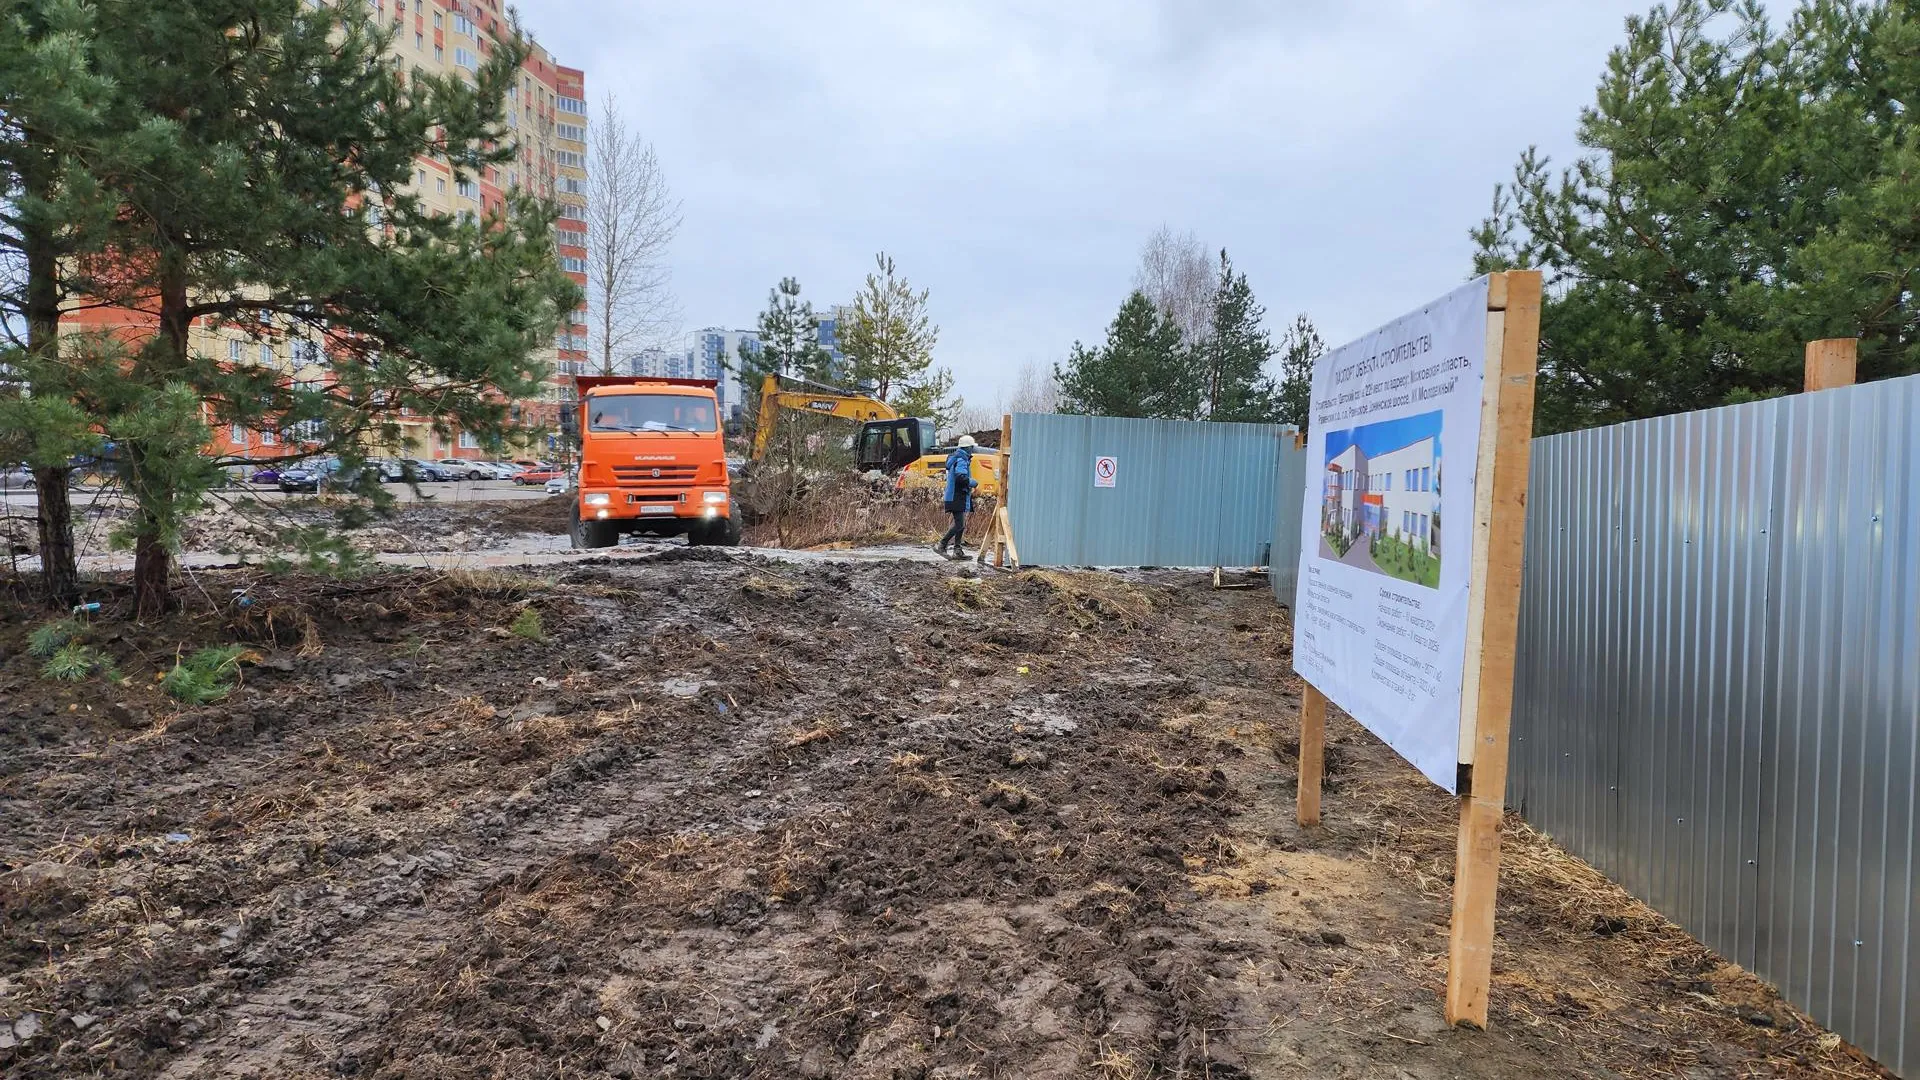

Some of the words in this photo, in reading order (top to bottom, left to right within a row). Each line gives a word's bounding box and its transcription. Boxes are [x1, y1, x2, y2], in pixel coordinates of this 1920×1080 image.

[1356, 355, 1379, 378] ОБЪЕКТА
[1380, 333, 1433, 368] СТРОИТЕЛЬСТВА
[1441, 355, 1472, 374] область,
